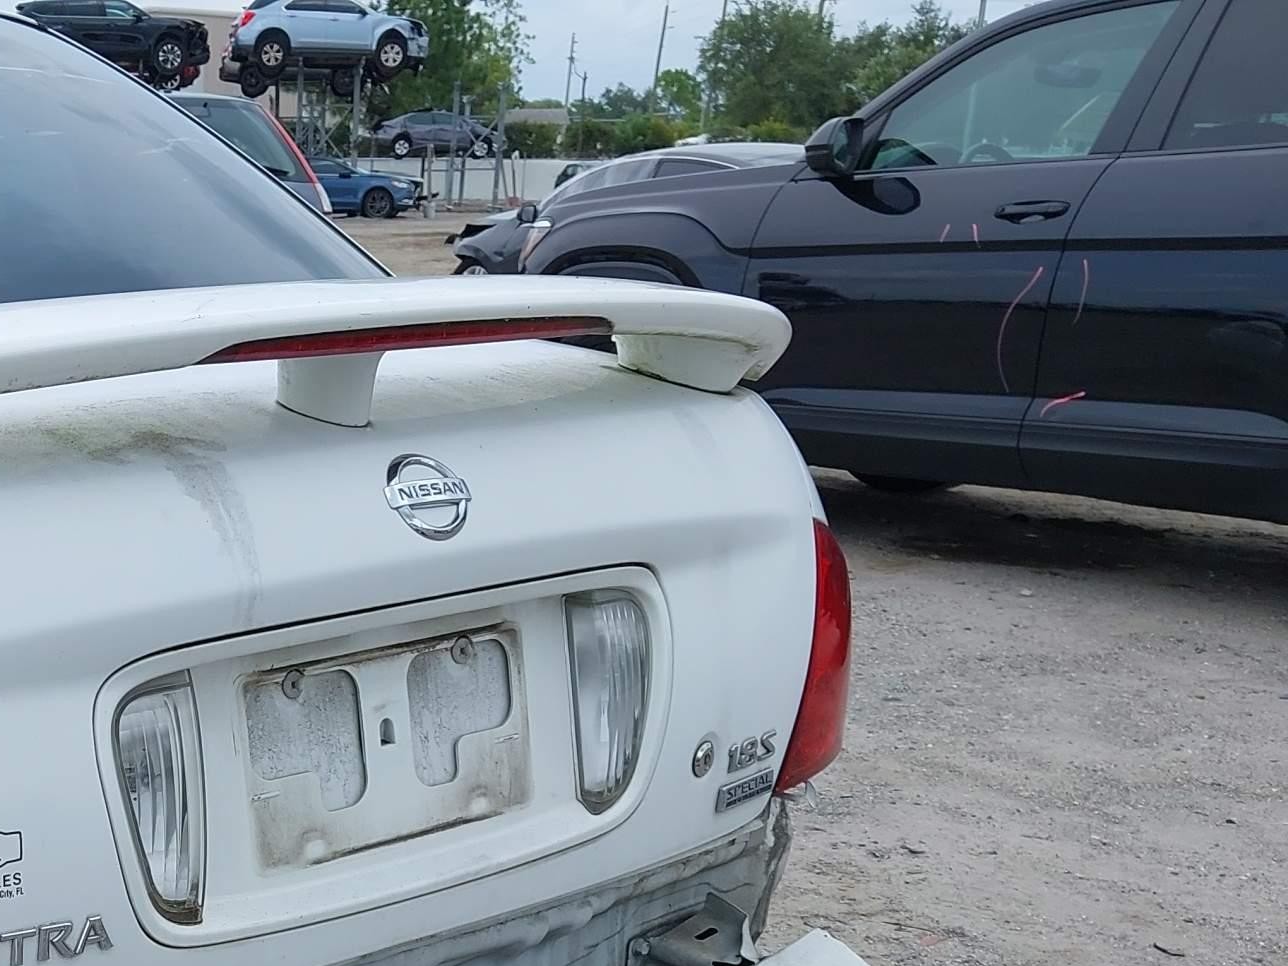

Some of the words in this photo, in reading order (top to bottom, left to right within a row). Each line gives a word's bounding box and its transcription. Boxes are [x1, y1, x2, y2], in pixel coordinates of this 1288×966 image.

[397, 481, 465, 501] NISSAN
[726, 773, 773, 801] SPECIAL
[0, 889, 14, 899] City,
[16, 887, 24, 896] FL
